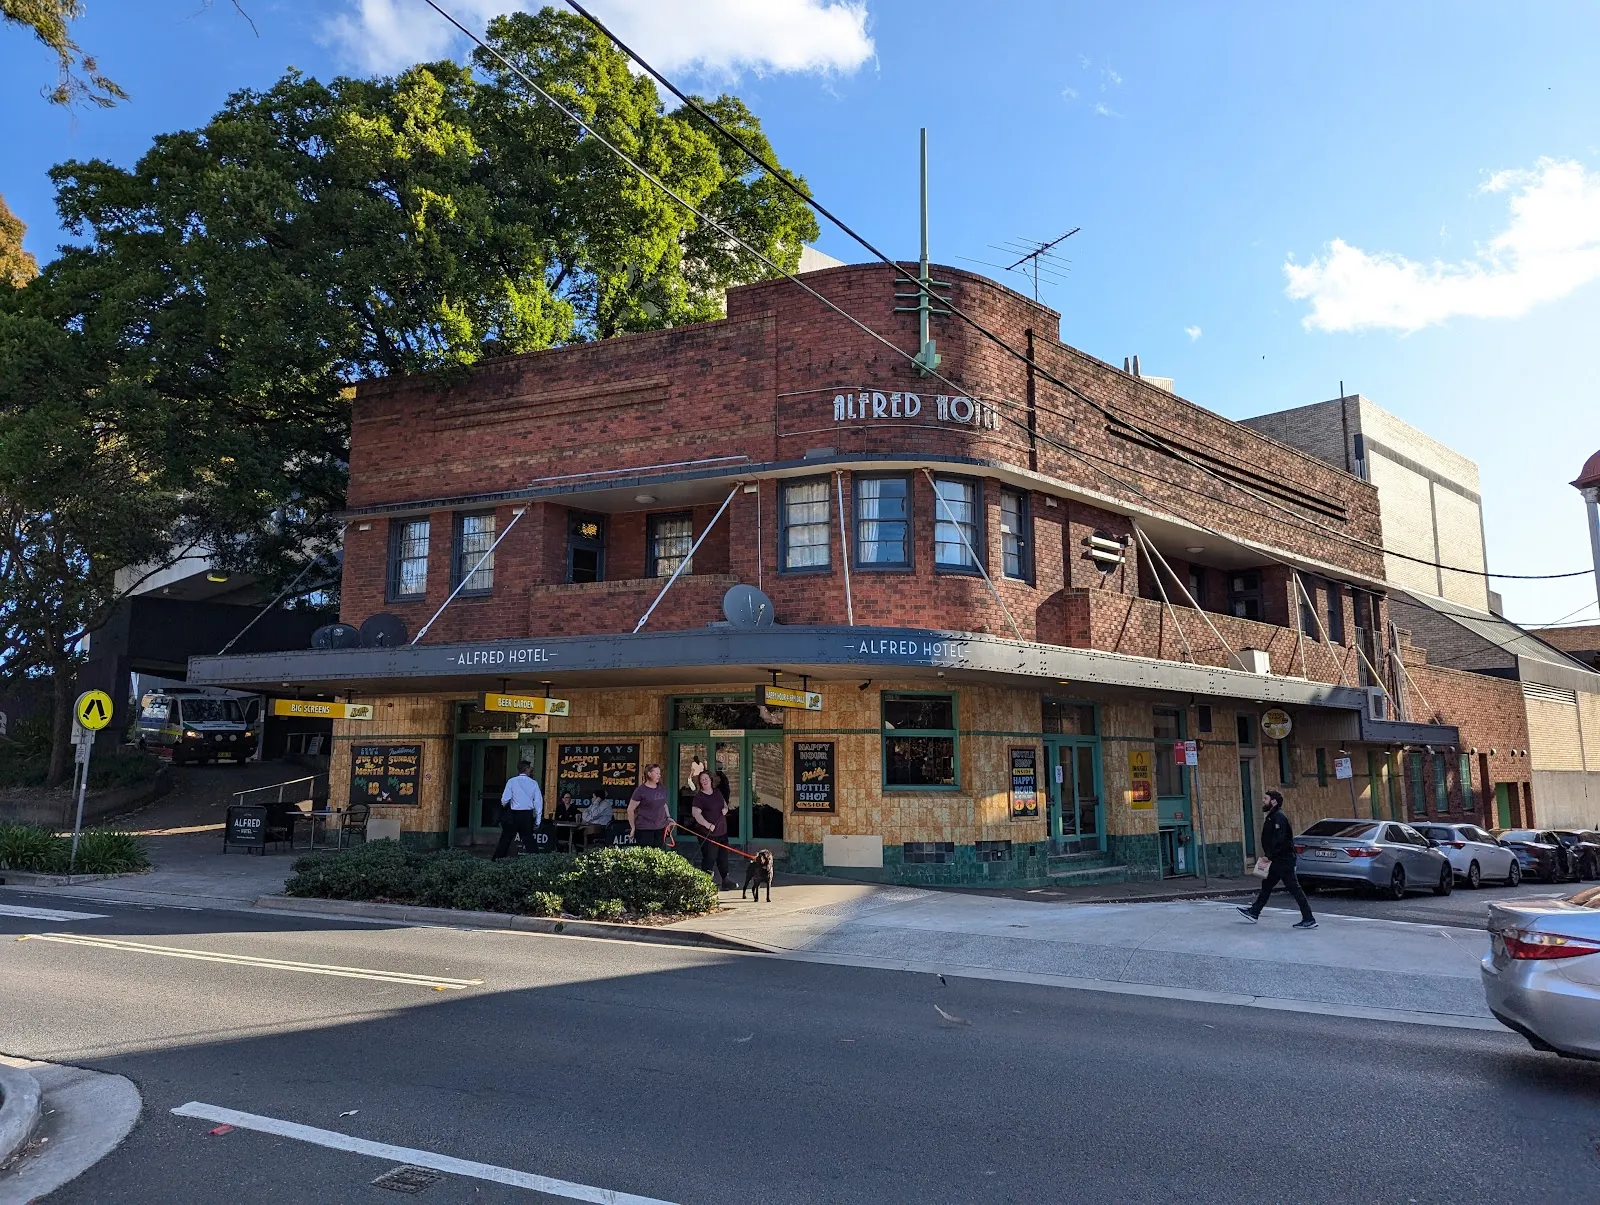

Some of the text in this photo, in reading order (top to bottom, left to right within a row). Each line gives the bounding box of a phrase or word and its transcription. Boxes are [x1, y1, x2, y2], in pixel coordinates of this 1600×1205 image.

[833, 392, 921, 421] ALFRED
[860, 640, 964, 658] ALFRED HOTEL
[458, 649, 549, 665] ALFRED HOTEL
[498, 698, 534, 709] BEER GARDEN
[291, 704, 330, 714] BIG SCREENS
[564, 746, 634, 754] FRIDAYS
[798, 743, 830, 751] HAPPY
[355, 755, 385, 764] JUG OF
[387, 755, 418, 765] SUNDAY
[560, 756, 600, 765] JACKPOT
[800, 751, 828, 760] HOUR
[355, 766, 384, 776] MONTH
[387, 766, 417, 776] ROAST
[602, 762, 636, 773] LIVE
[560, 769, 599, 779] JOKER
[801, 766, 829, 782] Daily
[602, 775, 636, 786] MUSIC
[1013, 776, 1034, 785] HAPPY
[796, 783, 831, 792] BOTTLE
[1014, 785, 1034, 795] HOUR
[799, 792, 828, 801] SHOP
[234, 818, 261, 828] ALFRED
